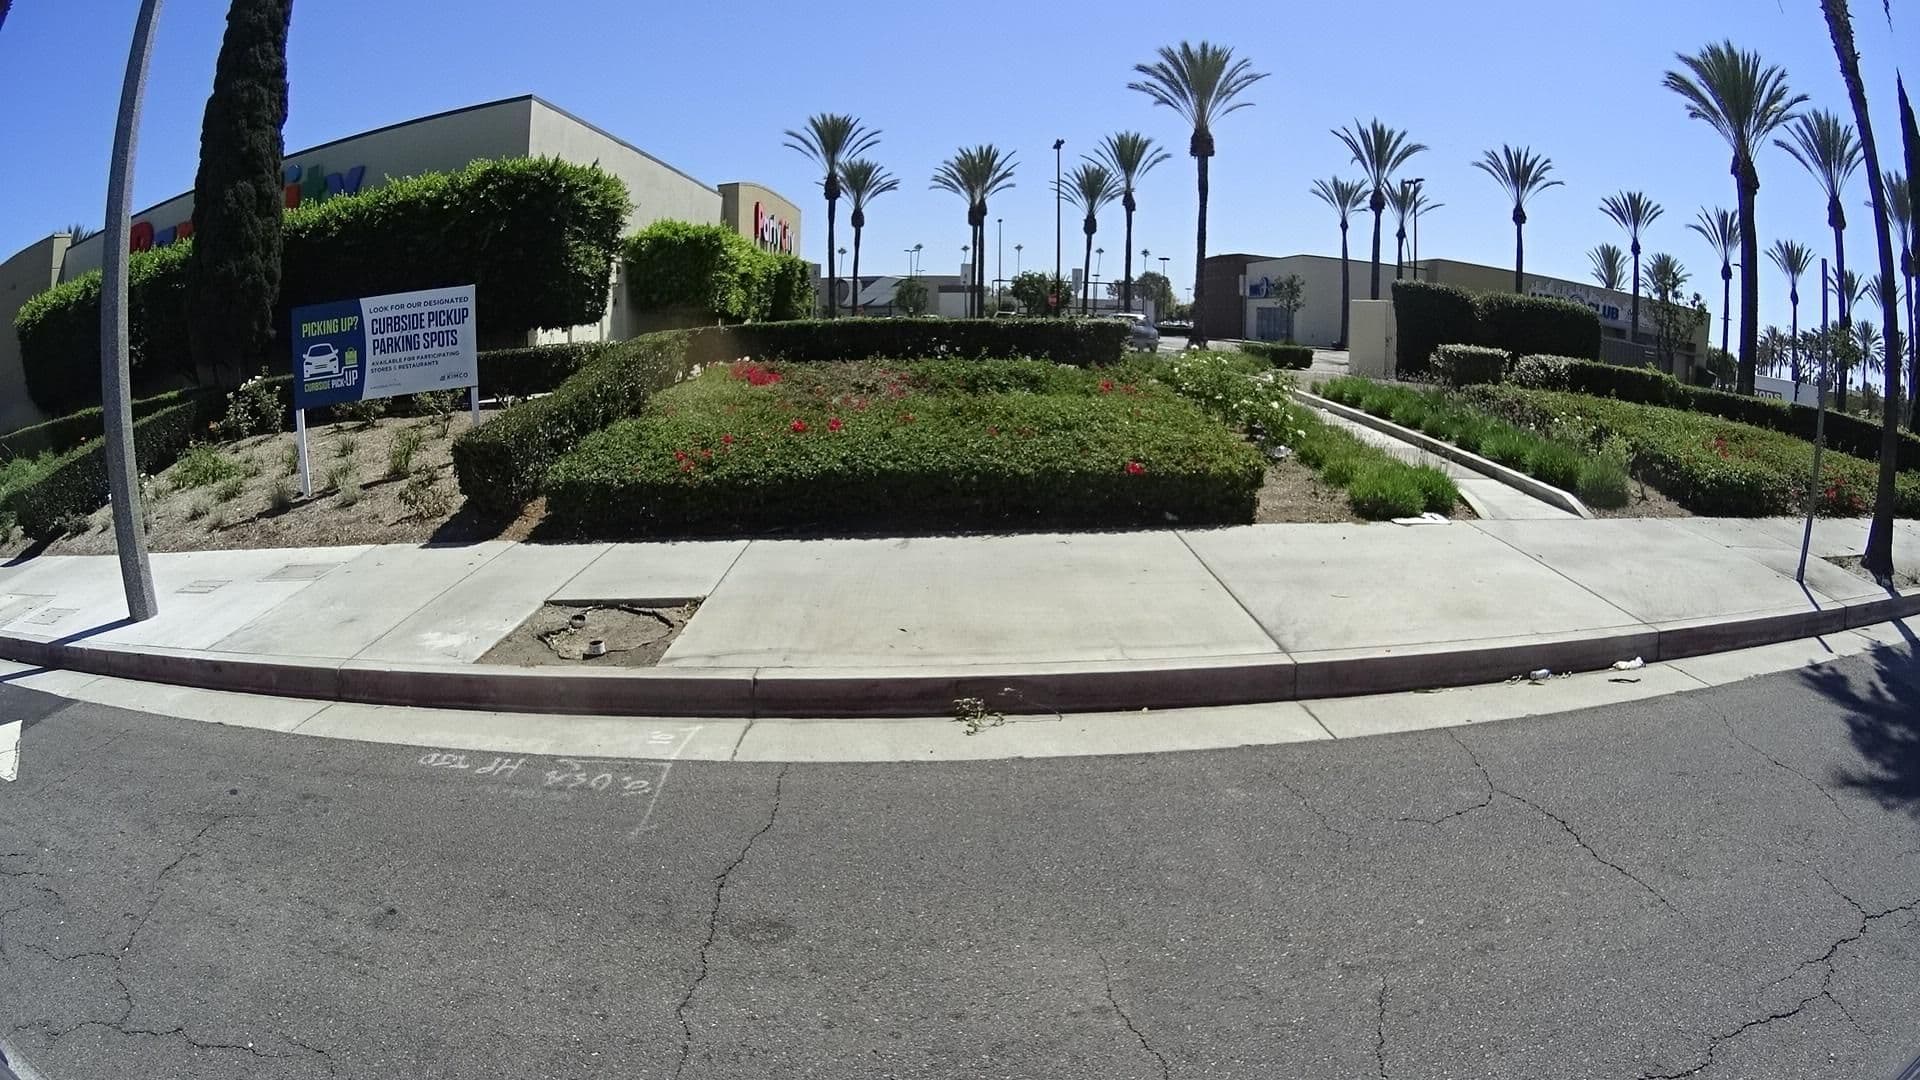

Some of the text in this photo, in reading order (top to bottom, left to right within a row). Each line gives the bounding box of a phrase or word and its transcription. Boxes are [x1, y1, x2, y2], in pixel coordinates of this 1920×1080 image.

[131, 222, 196, 251] Par
[754, 202, 780, 250] Party
[369, 296, 469, 314] LOOK FOR OUR DESIGNATED
[302, 315, 359, 338] PICKING UP?
[371, 307, 469, 335] CURBSIDE PICKUP
[372, 329, 458, 356] PARKING SPOTS
[371, 350, 460, 366] AVAILABLE FOR PARTICIPATING
[371, 365, 392, 374] STORES
[398, 360, 438, 370] RESTAURANTS
[446, 372, 469, 380] KIMCO
